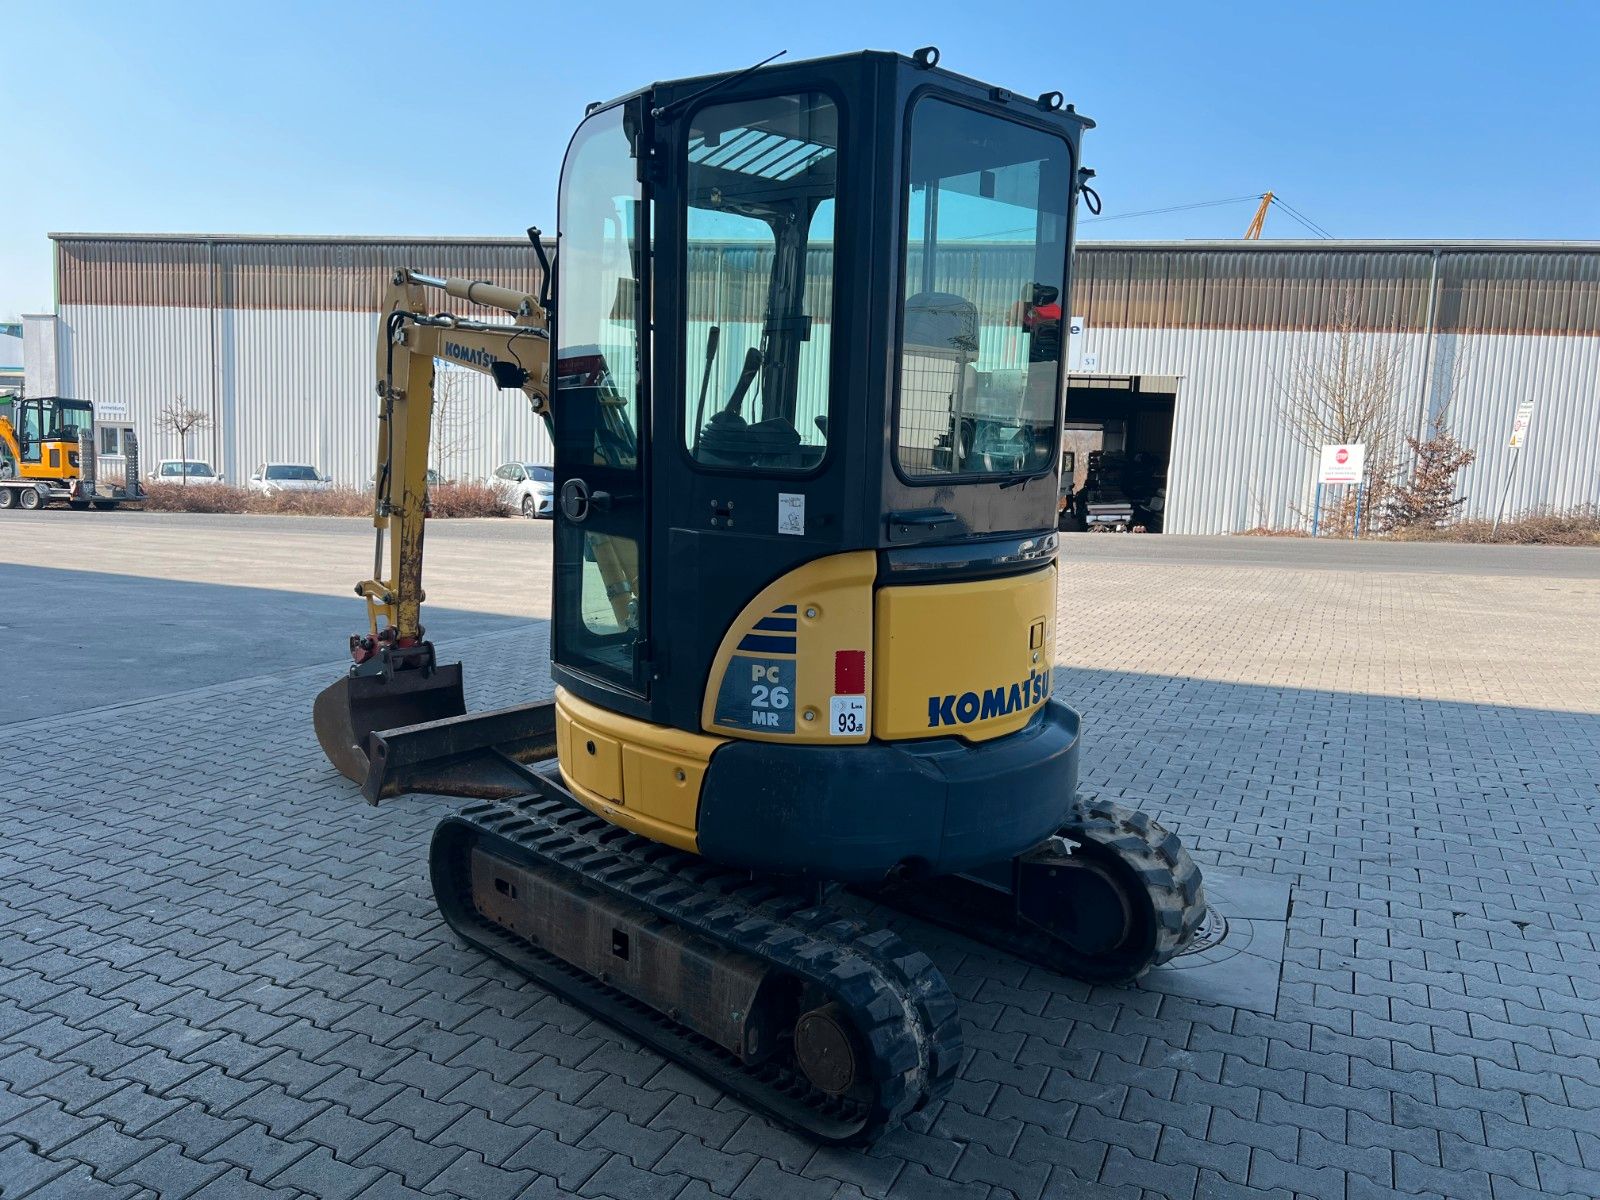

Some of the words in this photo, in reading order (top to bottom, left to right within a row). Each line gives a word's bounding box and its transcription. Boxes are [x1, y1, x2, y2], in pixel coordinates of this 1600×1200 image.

[752, 664, 780, 683] PC
[751, 685, 790, 709] 26
[928, 669, 1050, 728] KOMATSU
[752, 710, 780, 727] MR
